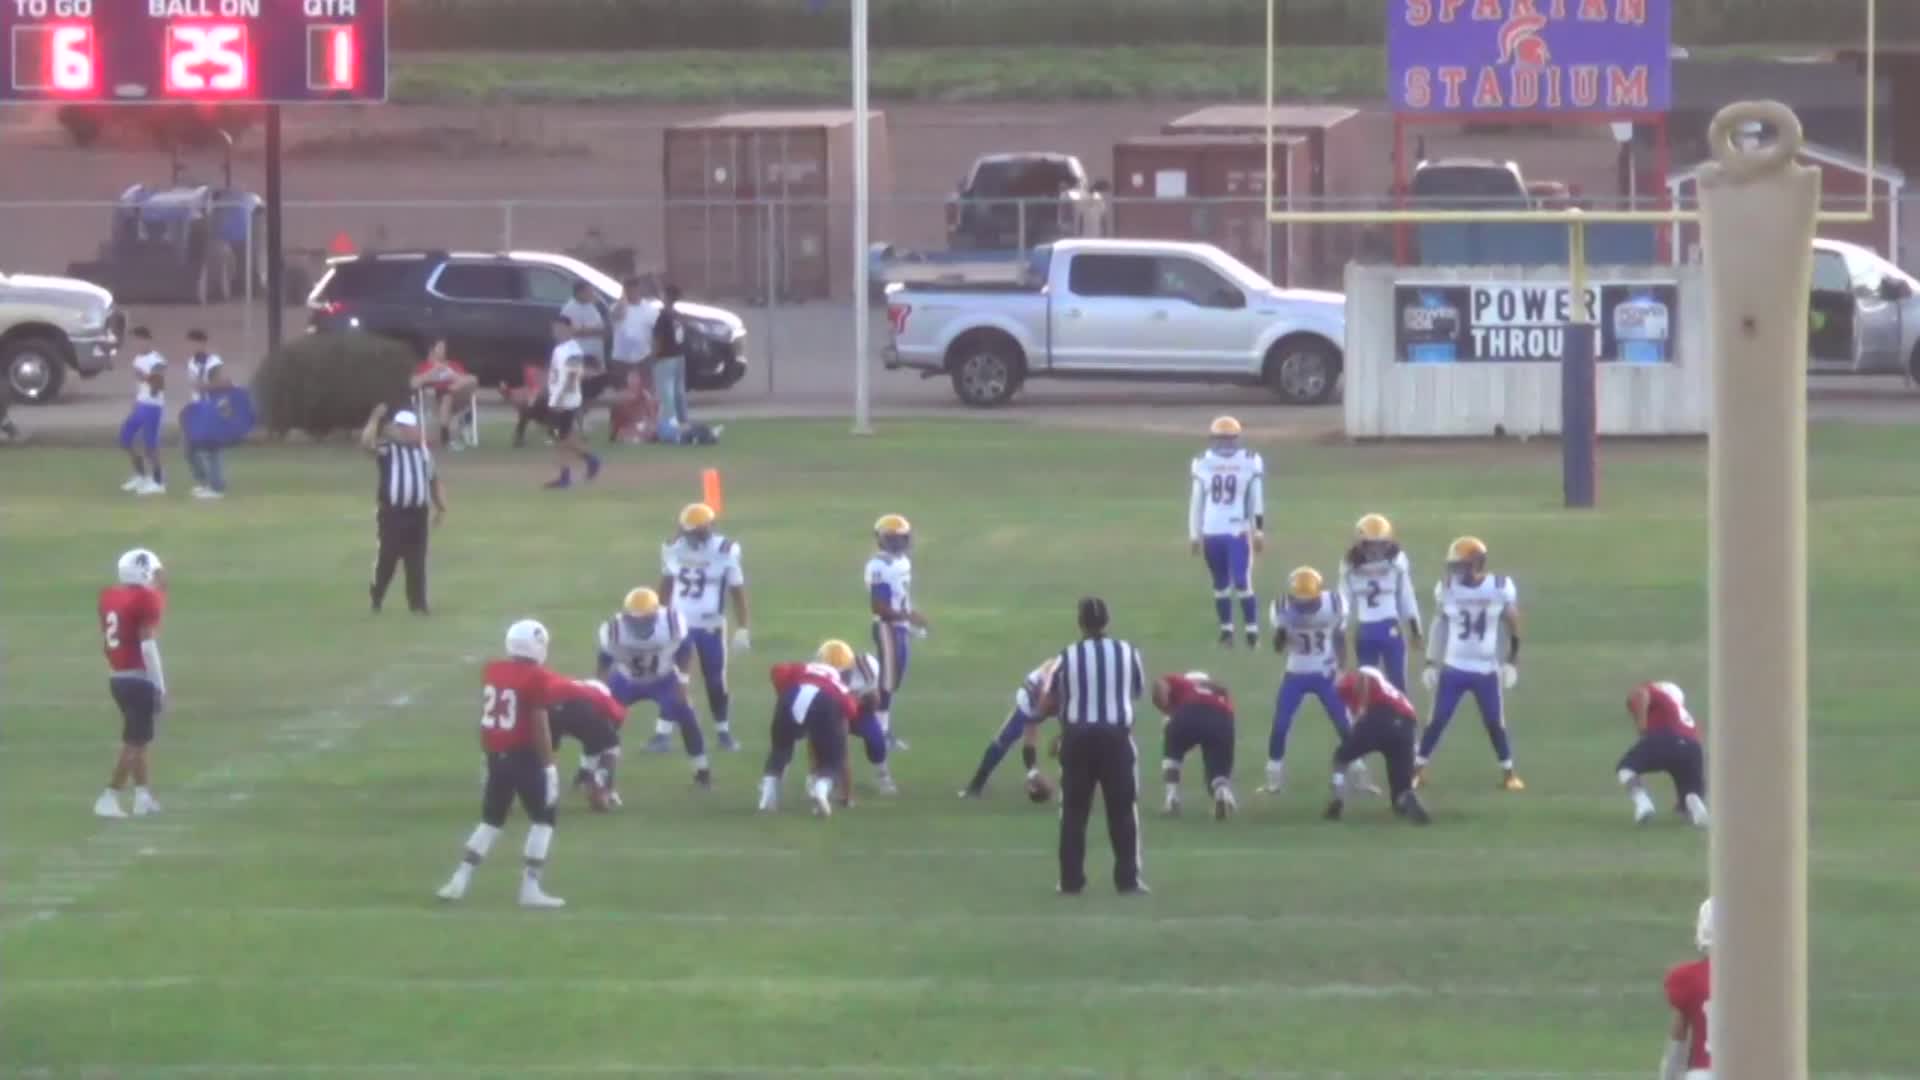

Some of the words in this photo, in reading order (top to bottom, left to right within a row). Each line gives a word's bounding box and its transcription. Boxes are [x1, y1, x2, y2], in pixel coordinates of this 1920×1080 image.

[15, 0, 48, 17] TO
[55, 0, 92, 17] GO
[148, 0, 214, 17] BALL
[220, 0, 259, 17] ON
[303, 0, 356, 17] QTR
[52, 26, 94, 90] 6
[170, 26, 247, 90] 25
[332, 28, 350, 86] 1
[1405, 65, 1648, 107] STADIUM
[1474, 289, 1596, 321] POWER
[1470, 328, 1602, 357] THROU
[679, 566, 705, 598] 53
[1366, 580, 1381, 608] 2
[106, 610, 120, 648] 2
[1458, 608, 1488, 642] 34
[481, 685, 517, 730] 23
